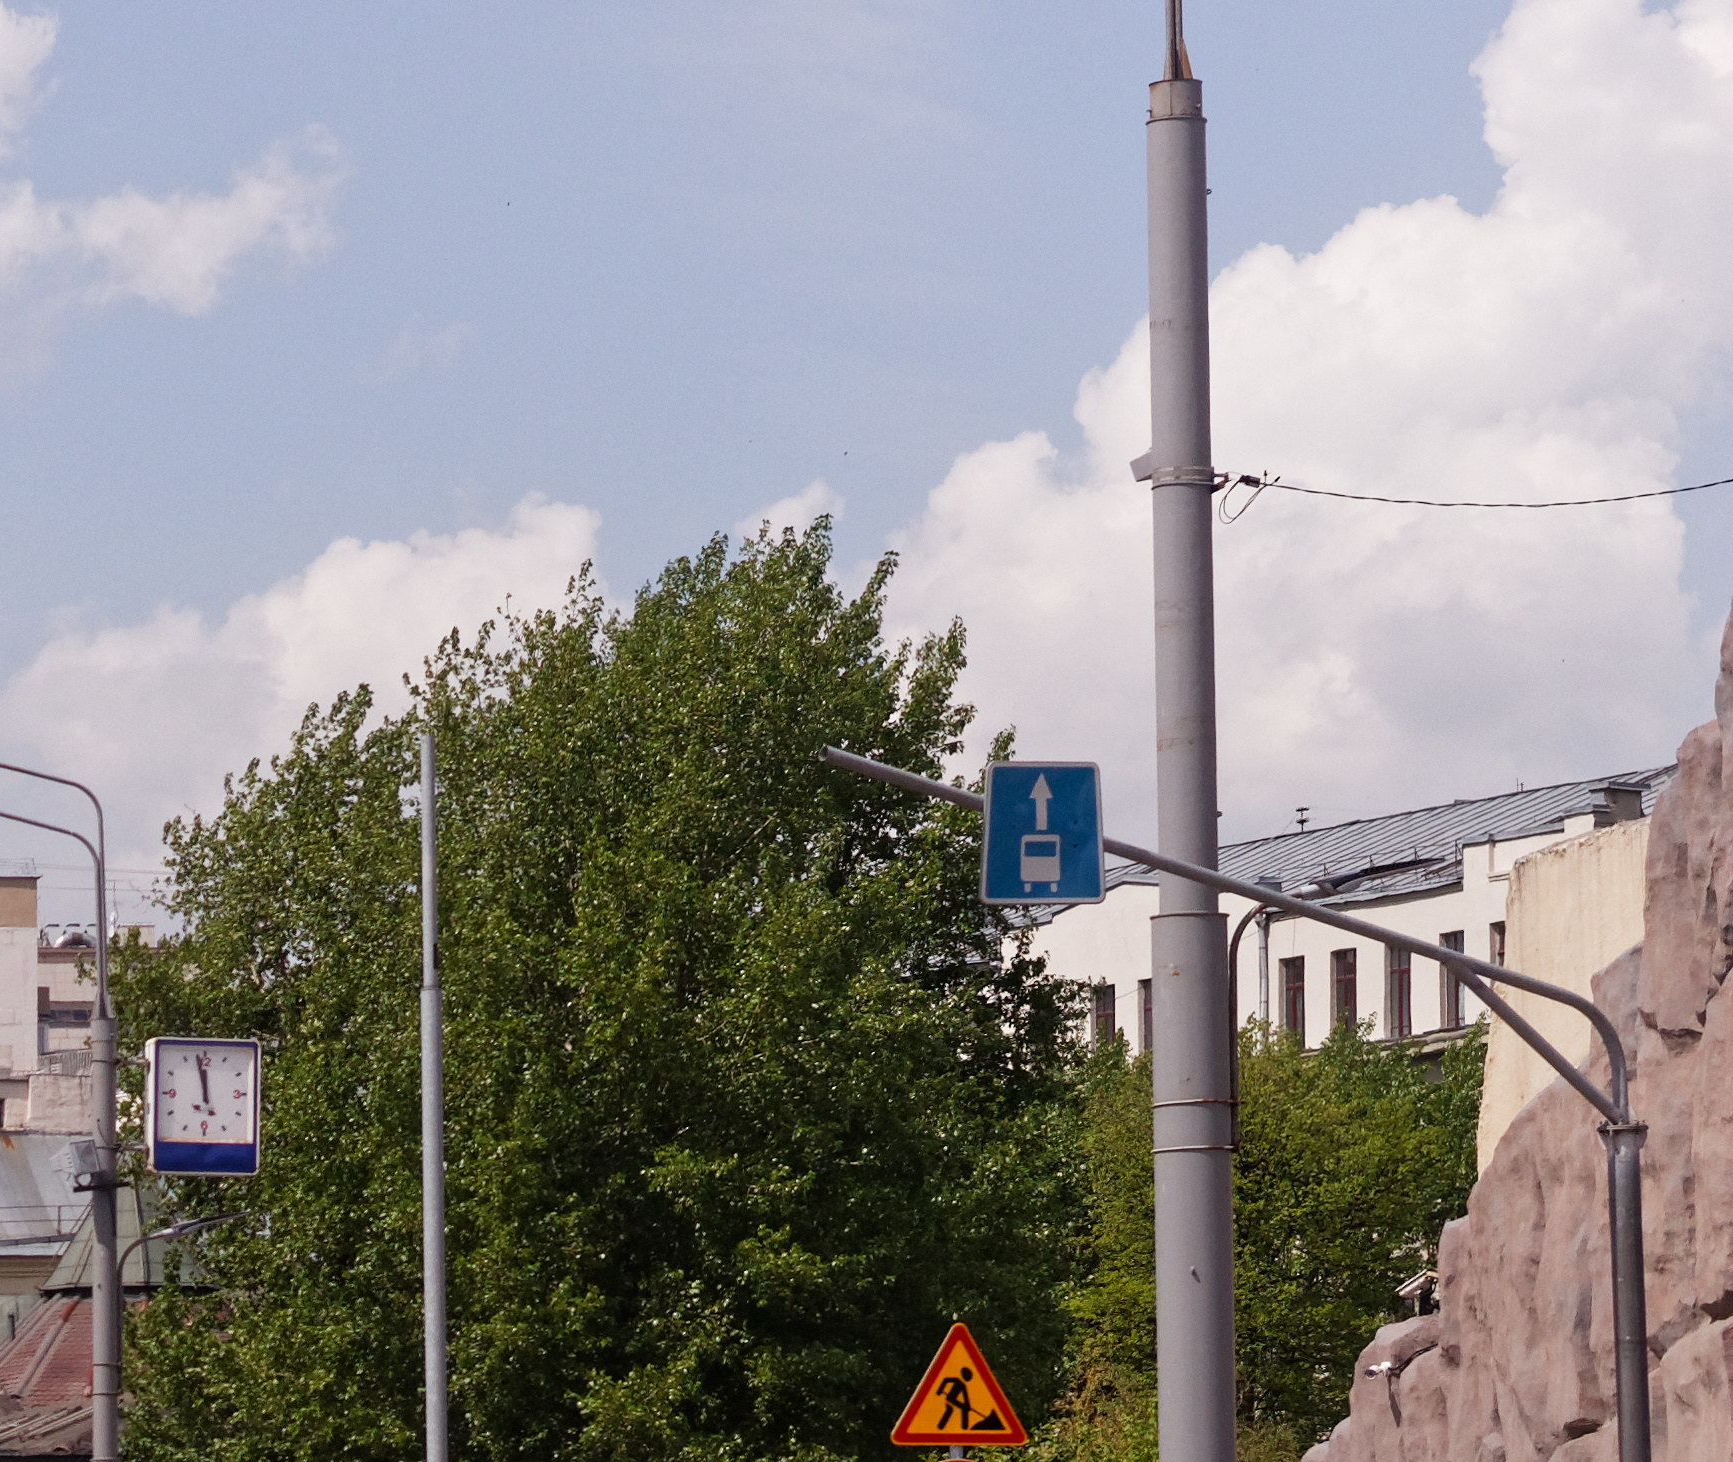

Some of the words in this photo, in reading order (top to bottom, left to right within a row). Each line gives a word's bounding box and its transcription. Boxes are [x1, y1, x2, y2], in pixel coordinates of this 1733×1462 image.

[169, 1088, 176, 1098] 9
[233, 1089, 241, 1099] 3
[200, 1120, 208, 1130] 6
